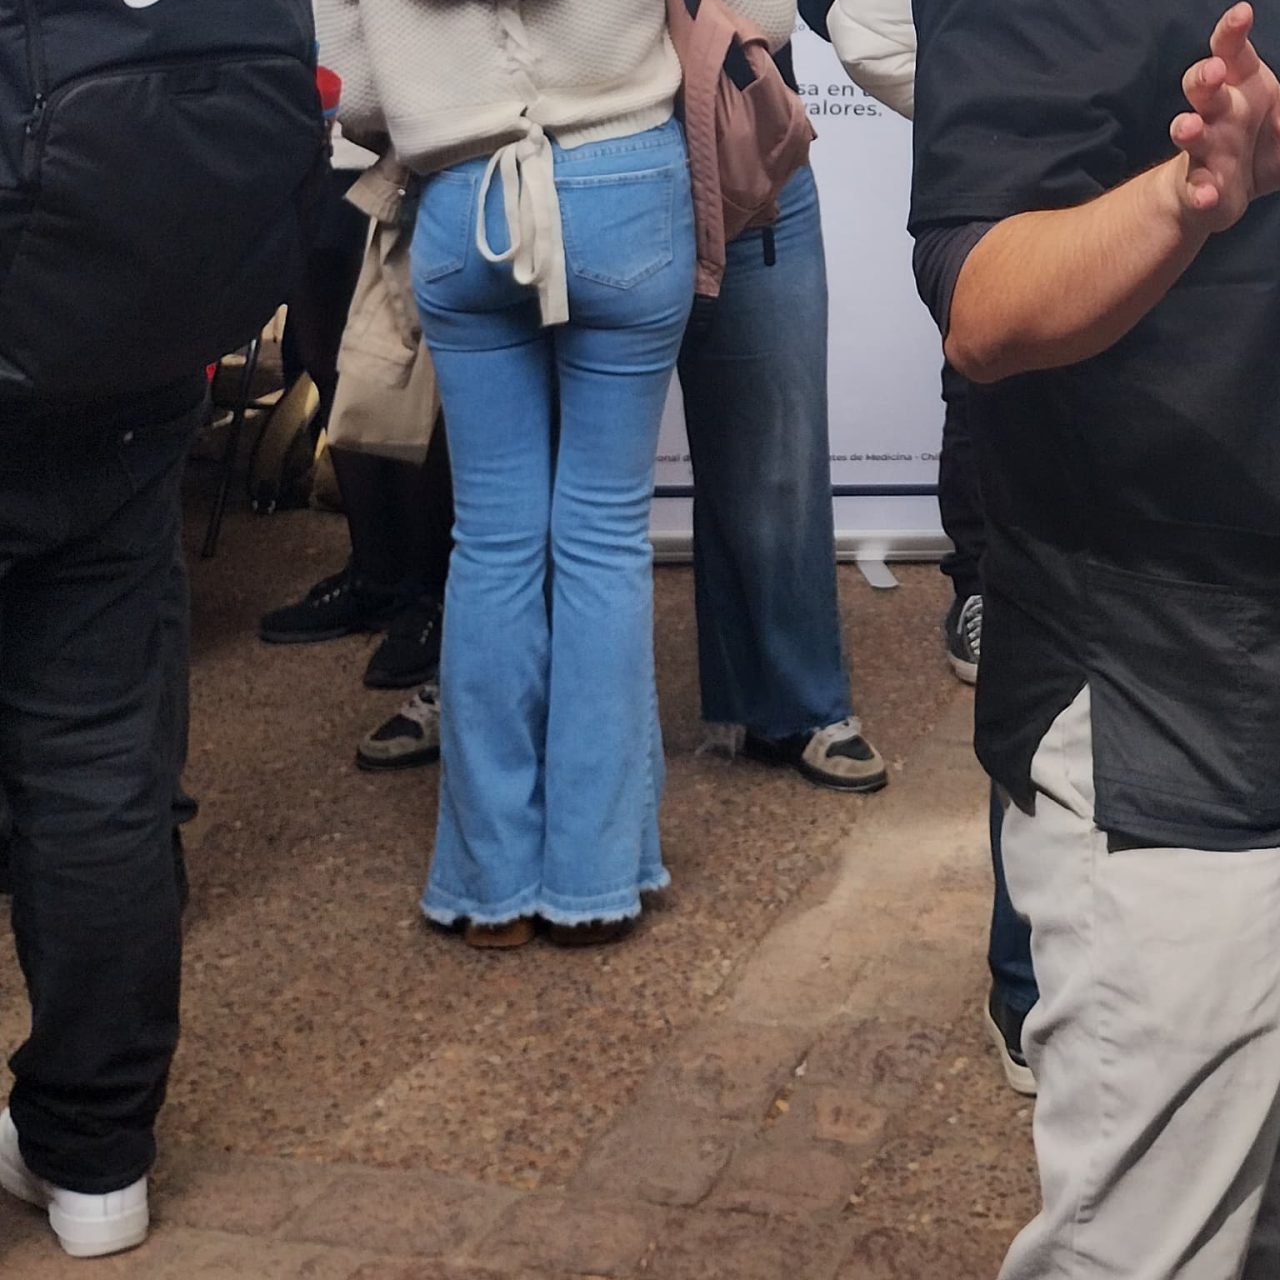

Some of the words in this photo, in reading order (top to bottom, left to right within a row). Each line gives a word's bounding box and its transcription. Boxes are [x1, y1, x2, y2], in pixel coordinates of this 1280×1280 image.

[798, 83, 819, 96] sa
[827, 83, 855, 97] en
[805, 100, 882, 117] alores.
[865, 453, 913, 461] Medicina
